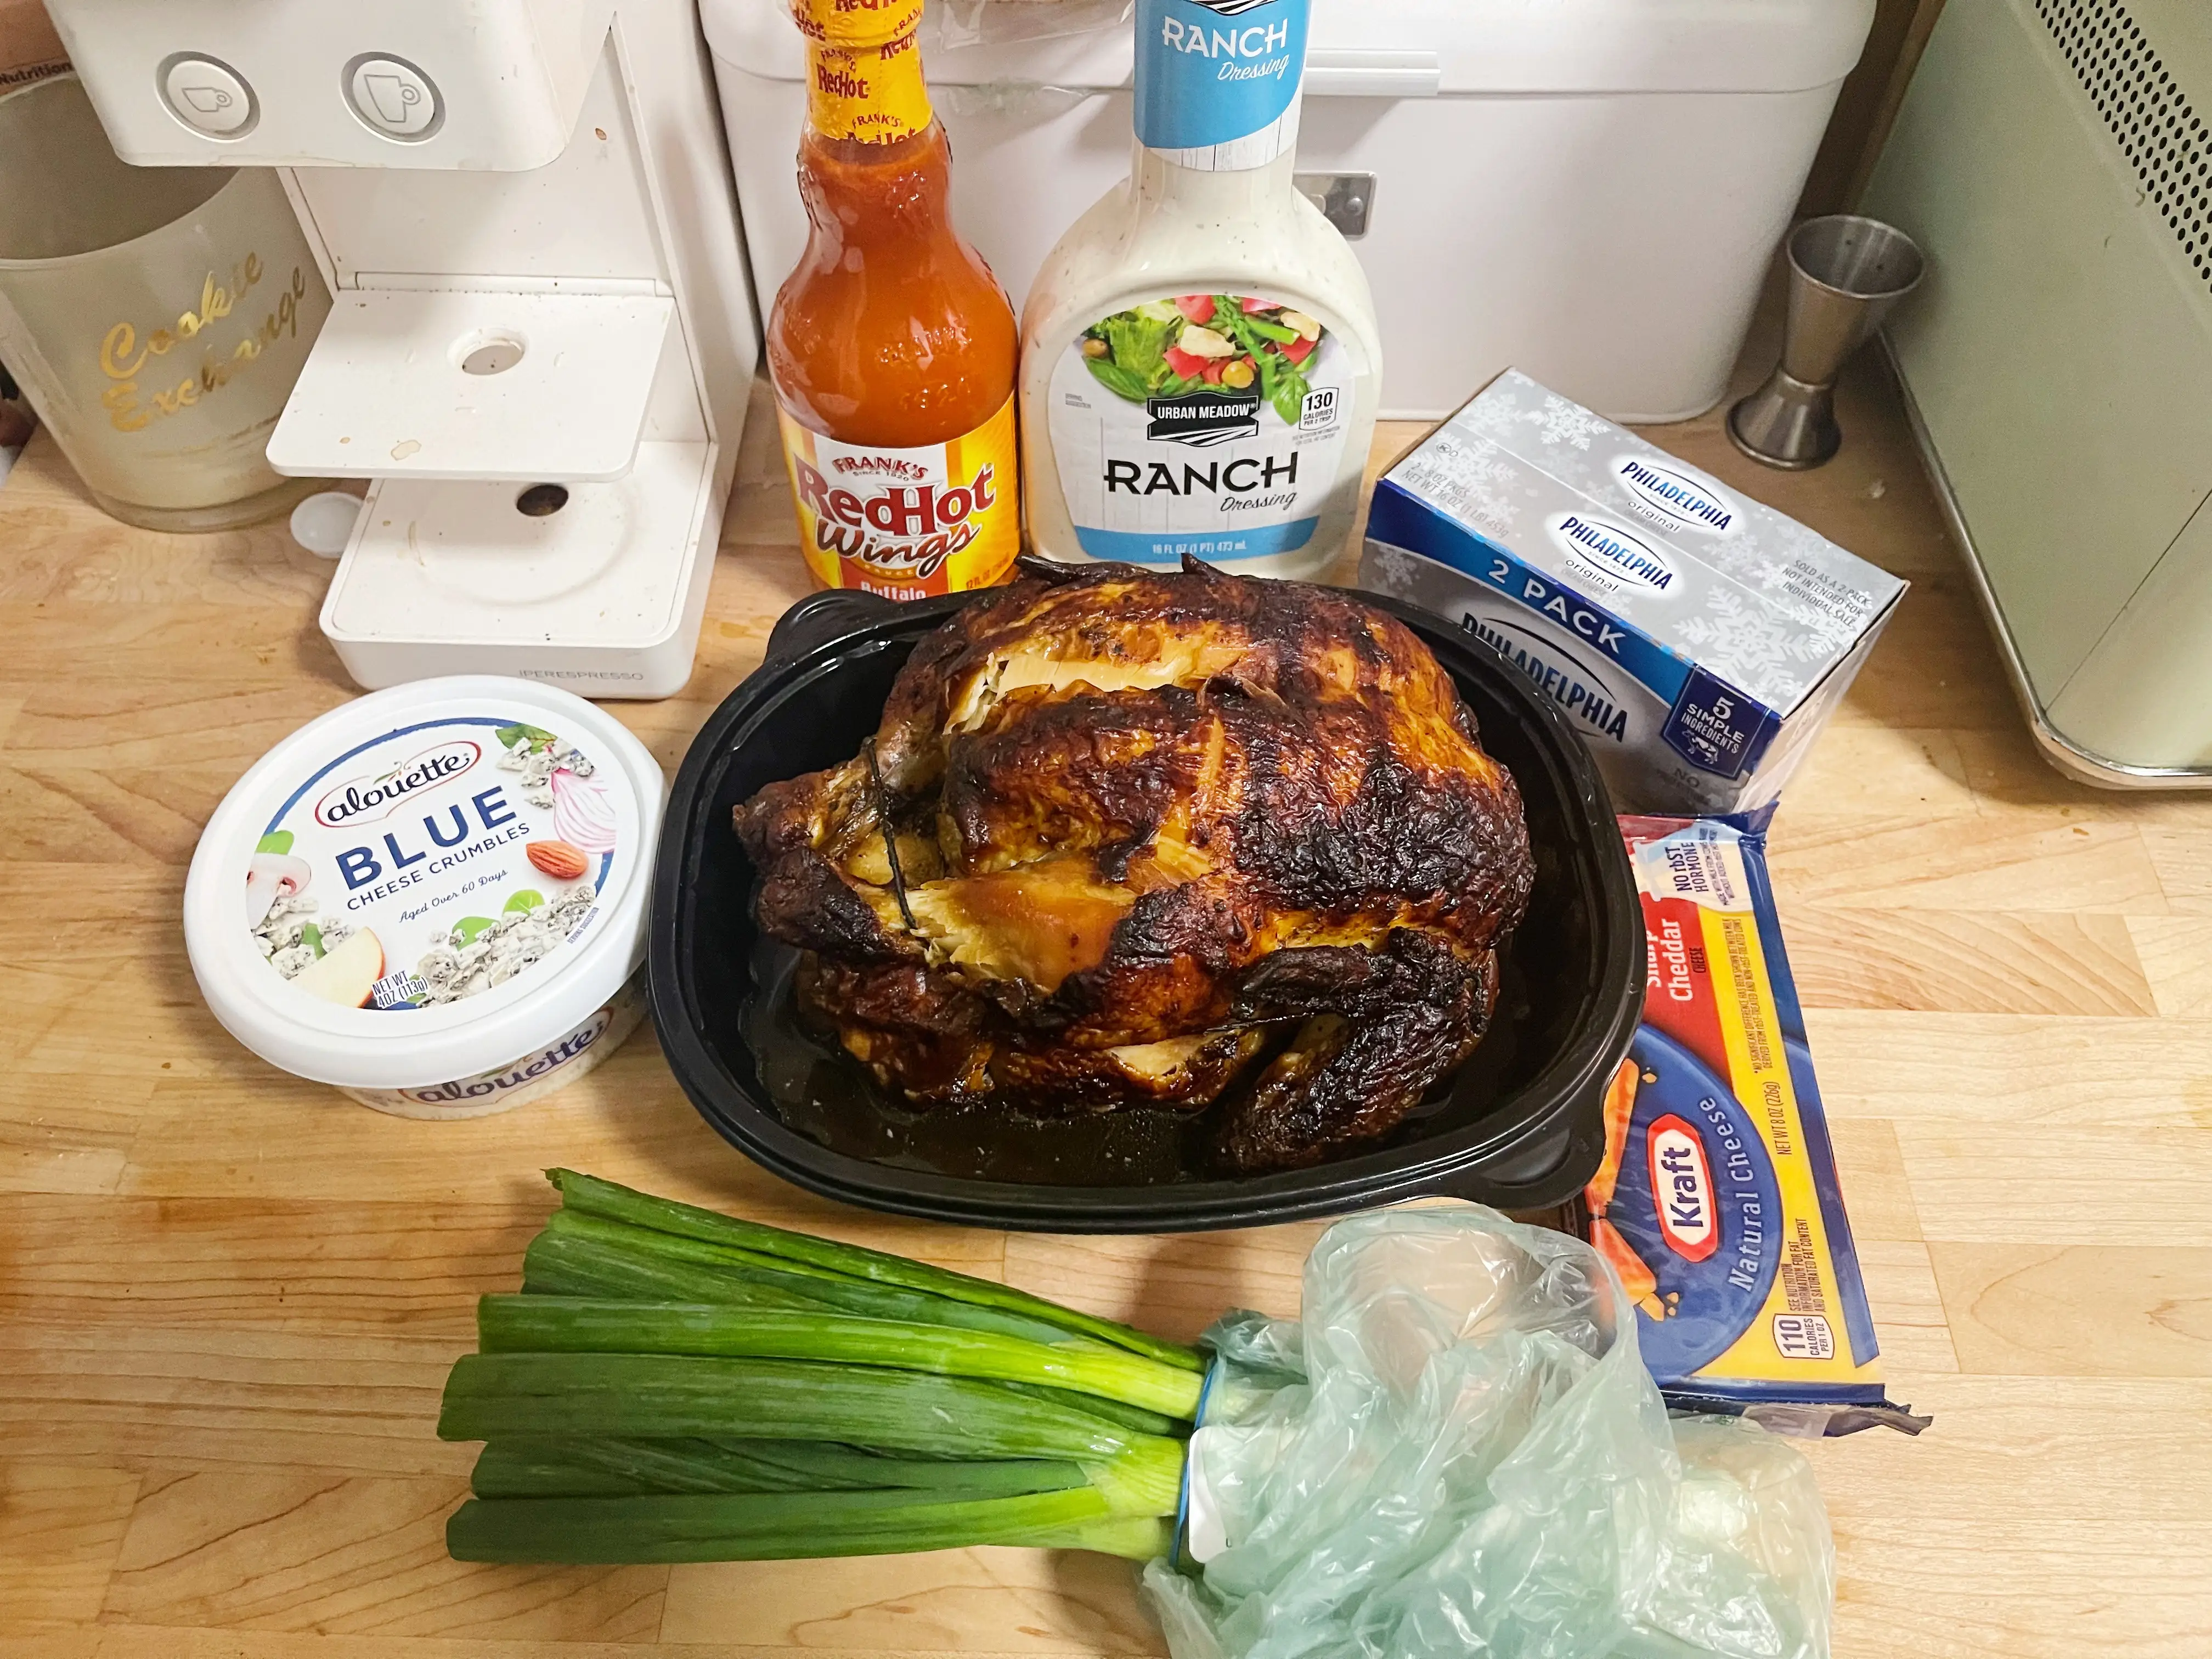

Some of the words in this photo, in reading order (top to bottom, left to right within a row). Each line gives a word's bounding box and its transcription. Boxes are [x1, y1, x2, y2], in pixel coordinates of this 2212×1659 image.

[1161, 16, 1288, 58] RANCH
[816, 63, 868, 99] RedHot
[1217, 54, 1290, 81] Dressing
[852, 114, 900, 129] FRANK'S
[100, 251, 263, 380] Cookie
[1158, 406, 1196, 419] URBAN
[1199, 403, 1250, 419] MEADOW
[1306, 392, 1333, 411] 130
[833, 456, 928, 481] FRANK'S
[1103, 452, 1299, 496] RANCH
[794, 453, 995, 536] RedHot
[1220, 492, 1298, 512] Dressing
[1401, 469, 1423, 486] NET
[1419, 479, 1438, 494] WT
[1435, 488, 1449, 500] 16
[1446, 495, 1464, 509] OZ
[1620, 461, 1733, 531] PHILADELPHIA
[1628, 500, 1681, 532] original
[817, 518, 981, 577] Wings
[1559, 516, 1674, 590] PHILADELPHIA
[1565, 558, 1619, 592] original
[1781, 566, 1803, 582] NOT
[1801, 577, 1845, 606] INTENDED
[1843, 602, 1864, 617] FOR
[1792, 558, 1818, 577] SOLD
[1815, 572, 1830, 583] AS
[1828, 579, 1838, 588] A
[1837, 583, 1870, 606] 2-PACK
[1488, 559, 1509, 584] 2
[1523, 578, 1626, 654] PACK
[1781, 580, 1833, 613] INDIVIDUAL
[1832, 610, 1856, 627] SALE
[1686, 702, 1745, 745] SIMPLE
[1712, 695, 1730, 719] 5
[1680, 712, 1739, 754] INGREDIENTS
[328, 753, 466, 822] alouette
[1675, 768, 1700, 787] NO
[335, 785, 517, 891] BLUE
[347, 870, 424, 910] CHEESE
[429, 823, 530, 874] CRUMBLES
[1664, 845, 1688, 870] rbST
[1682, 842, 1709, 893] HORMONE
[399, 902, 429, 923] Aged
[432, 892, 459, 907] Over
[462, 881, 475, 894] 60
[478, 869, 508, 887] Days
[1672, 874, 1692, 893] NO
[1660, 918, 1694, 1001] Cheddar
[373, 978, 391, 995] NET
[392, 970, 408, 986] WT
[399, 977, 427, 1000] (113g)
[416, 1028, 601, 1102] alouette
[1762, 1082, 1784, 1105] (226g)
[1767, 1107, 1784, 1116] OZ
[1699, 1097, 1754, 1182] Cheese
[1771, 1125, 1788, 1136] WT
[1774, 1139, 1792, 1154] NET
[1661, 1146, 1703, 1228] Kraft
[1728, 1192, 1763, 1292] Natural
[1788, 1240, 1801, 1251] FAT
[1795, 1218, 1812, 1245] CONTENT
[1791, 1254, 1804, 1265] FOR
[1802, 1247, 1815, 1258] FAT
[1781, 1263, 1798, 1295] NUTRITION
[1793, 1267, 1814, 1311] INFORMATION
[1804, 1261, 1823, 1296] SATURATED
[1787, 1299, 1801, 1310] SEE
[1812, 1299, 1826, 1311] AND
[1779, 1319, 1805, 1351] 110
[1803, 1318, 1820, 1355] CALORIES
[1816, 1323, 1825, 1331] OZ
[1819, 1339, 1829, 1352] PER
